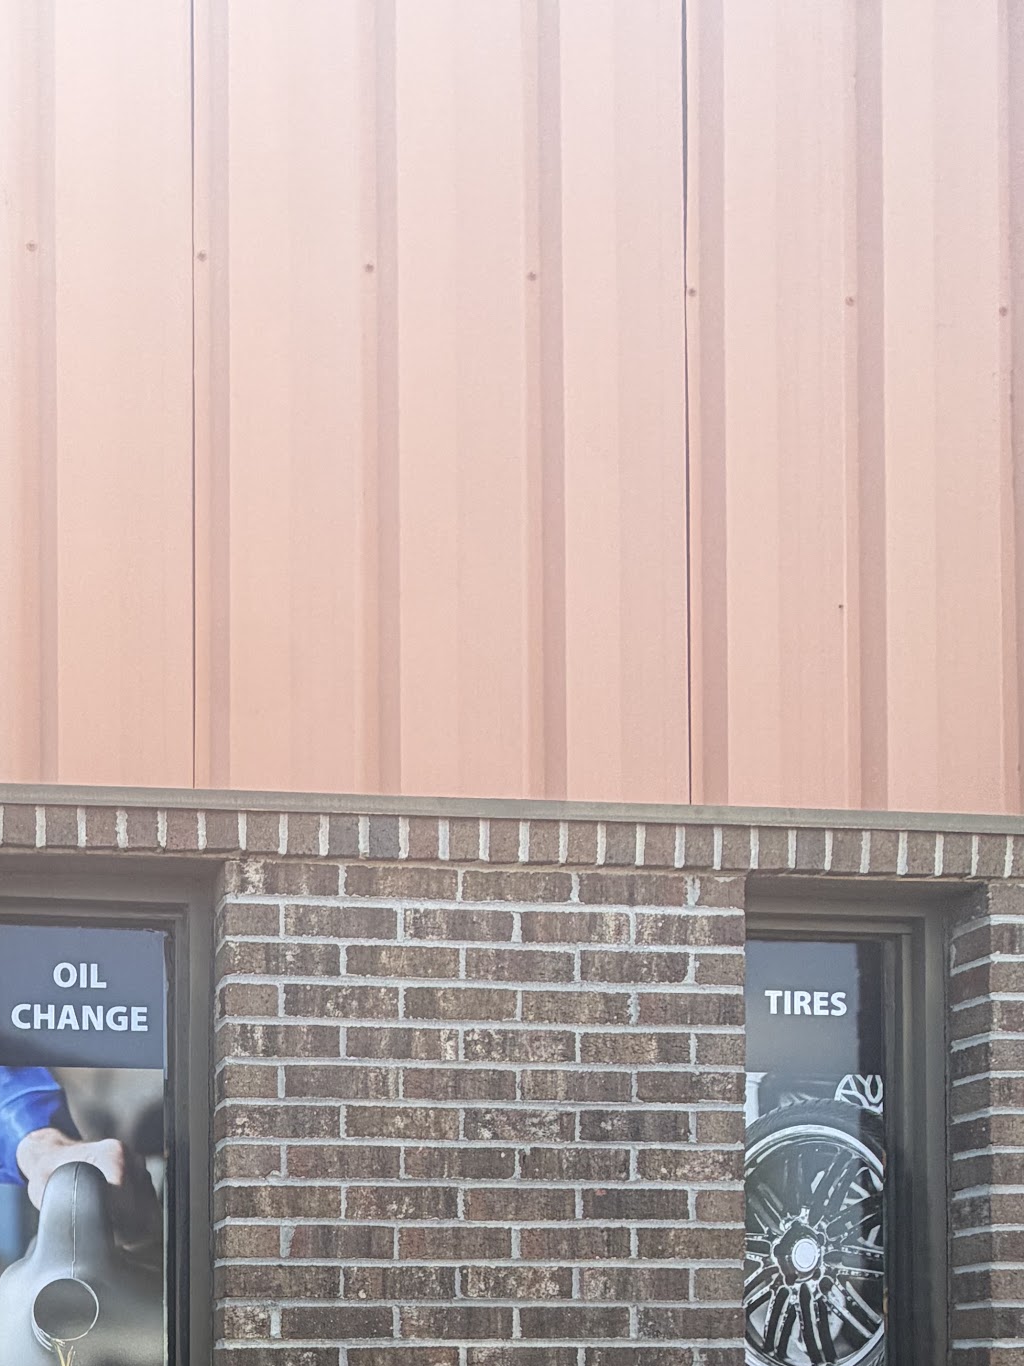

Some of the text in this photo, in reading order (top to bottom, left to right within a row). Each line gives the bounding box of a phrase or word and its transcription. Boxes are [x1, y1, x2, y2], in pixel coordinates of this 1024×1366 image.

[52, 962, 108, 989] OIL
[764, 989, 848, 1017] TIRES
[10, 1003, 149, 1032] CHANGE
